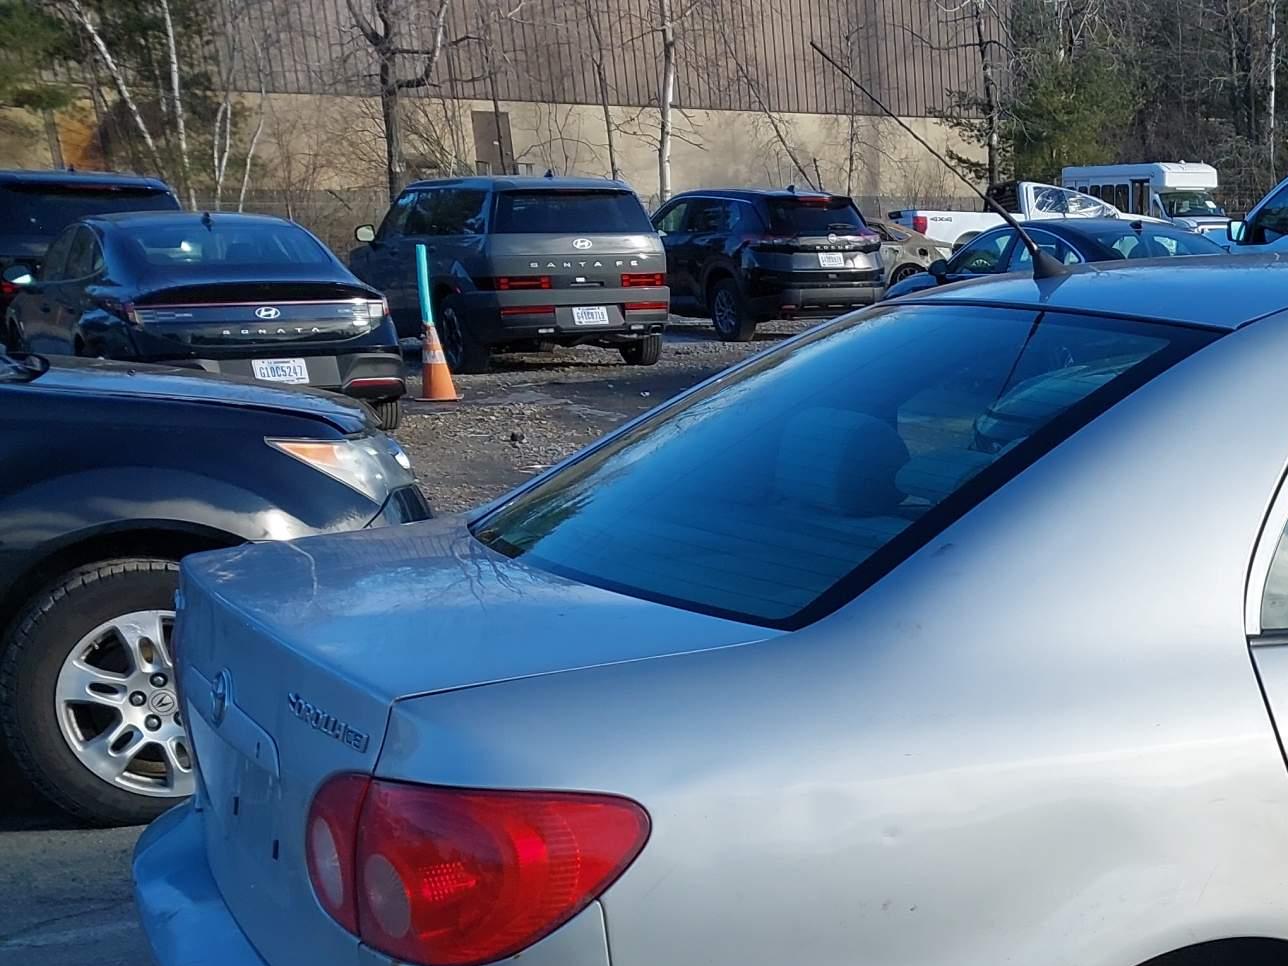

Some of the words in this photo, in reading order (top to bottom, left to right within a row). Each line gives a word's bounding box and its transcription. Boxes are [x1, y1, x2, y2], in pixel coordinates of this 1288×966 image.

[529, 260, 602, 268] SANTA
[615, 259, 639, 267] FE
[222, 327, 320, 336] SONATA
